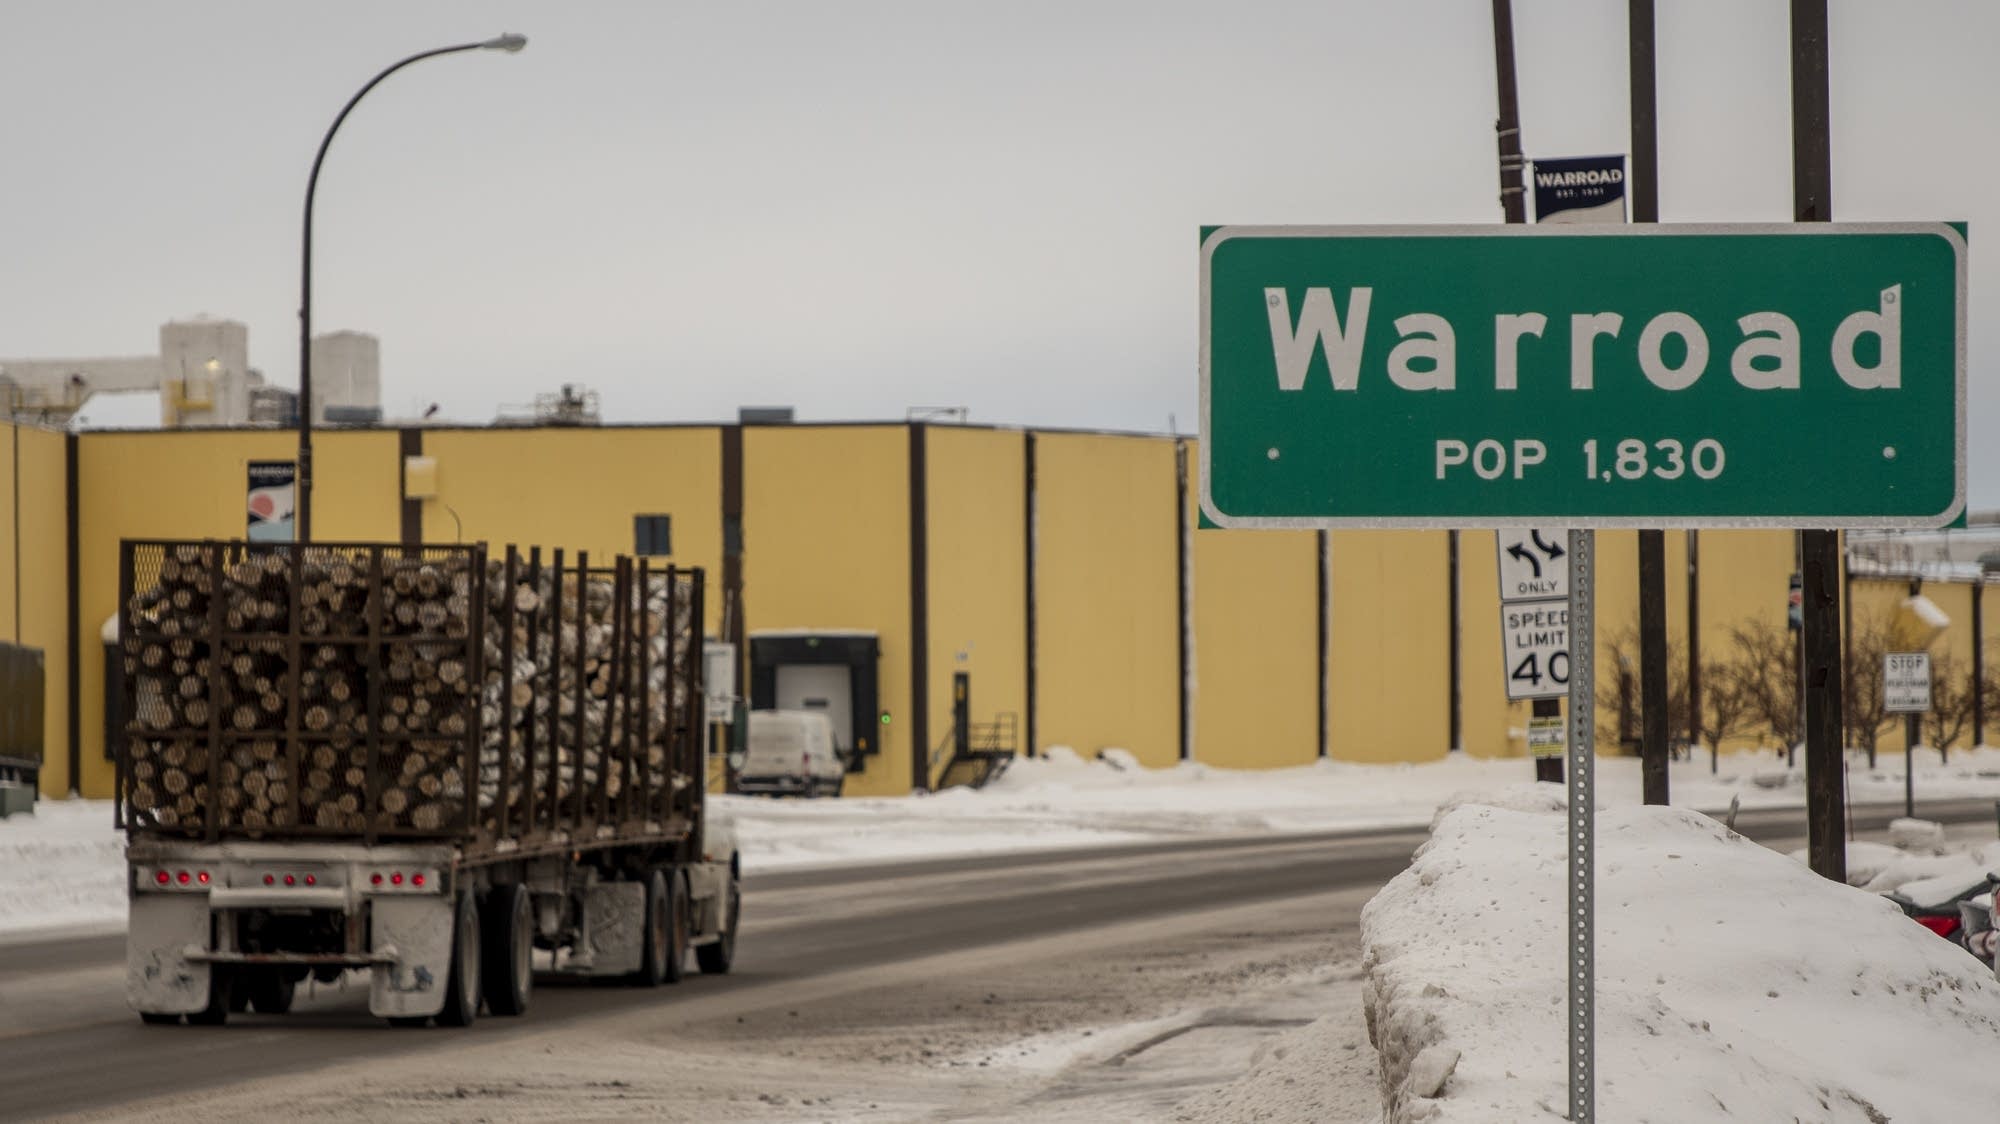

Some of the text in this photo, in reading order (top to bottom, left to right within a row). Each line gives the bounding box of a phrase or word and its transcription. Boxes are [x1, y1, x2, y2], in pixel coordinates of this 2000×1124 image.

[1537, 169, 1623, 187] WARROAD
[1265, 284, 1901, 390] Warroad
[1437, 439, 1725, 482] POP 1,830
[1518, 581, 1557, 594] ONLY
[1516, 631, 1565, 648] LIMIT
[1511, 651, 1568, 686] 40
[1890, 656, 1923, 669] STOP
